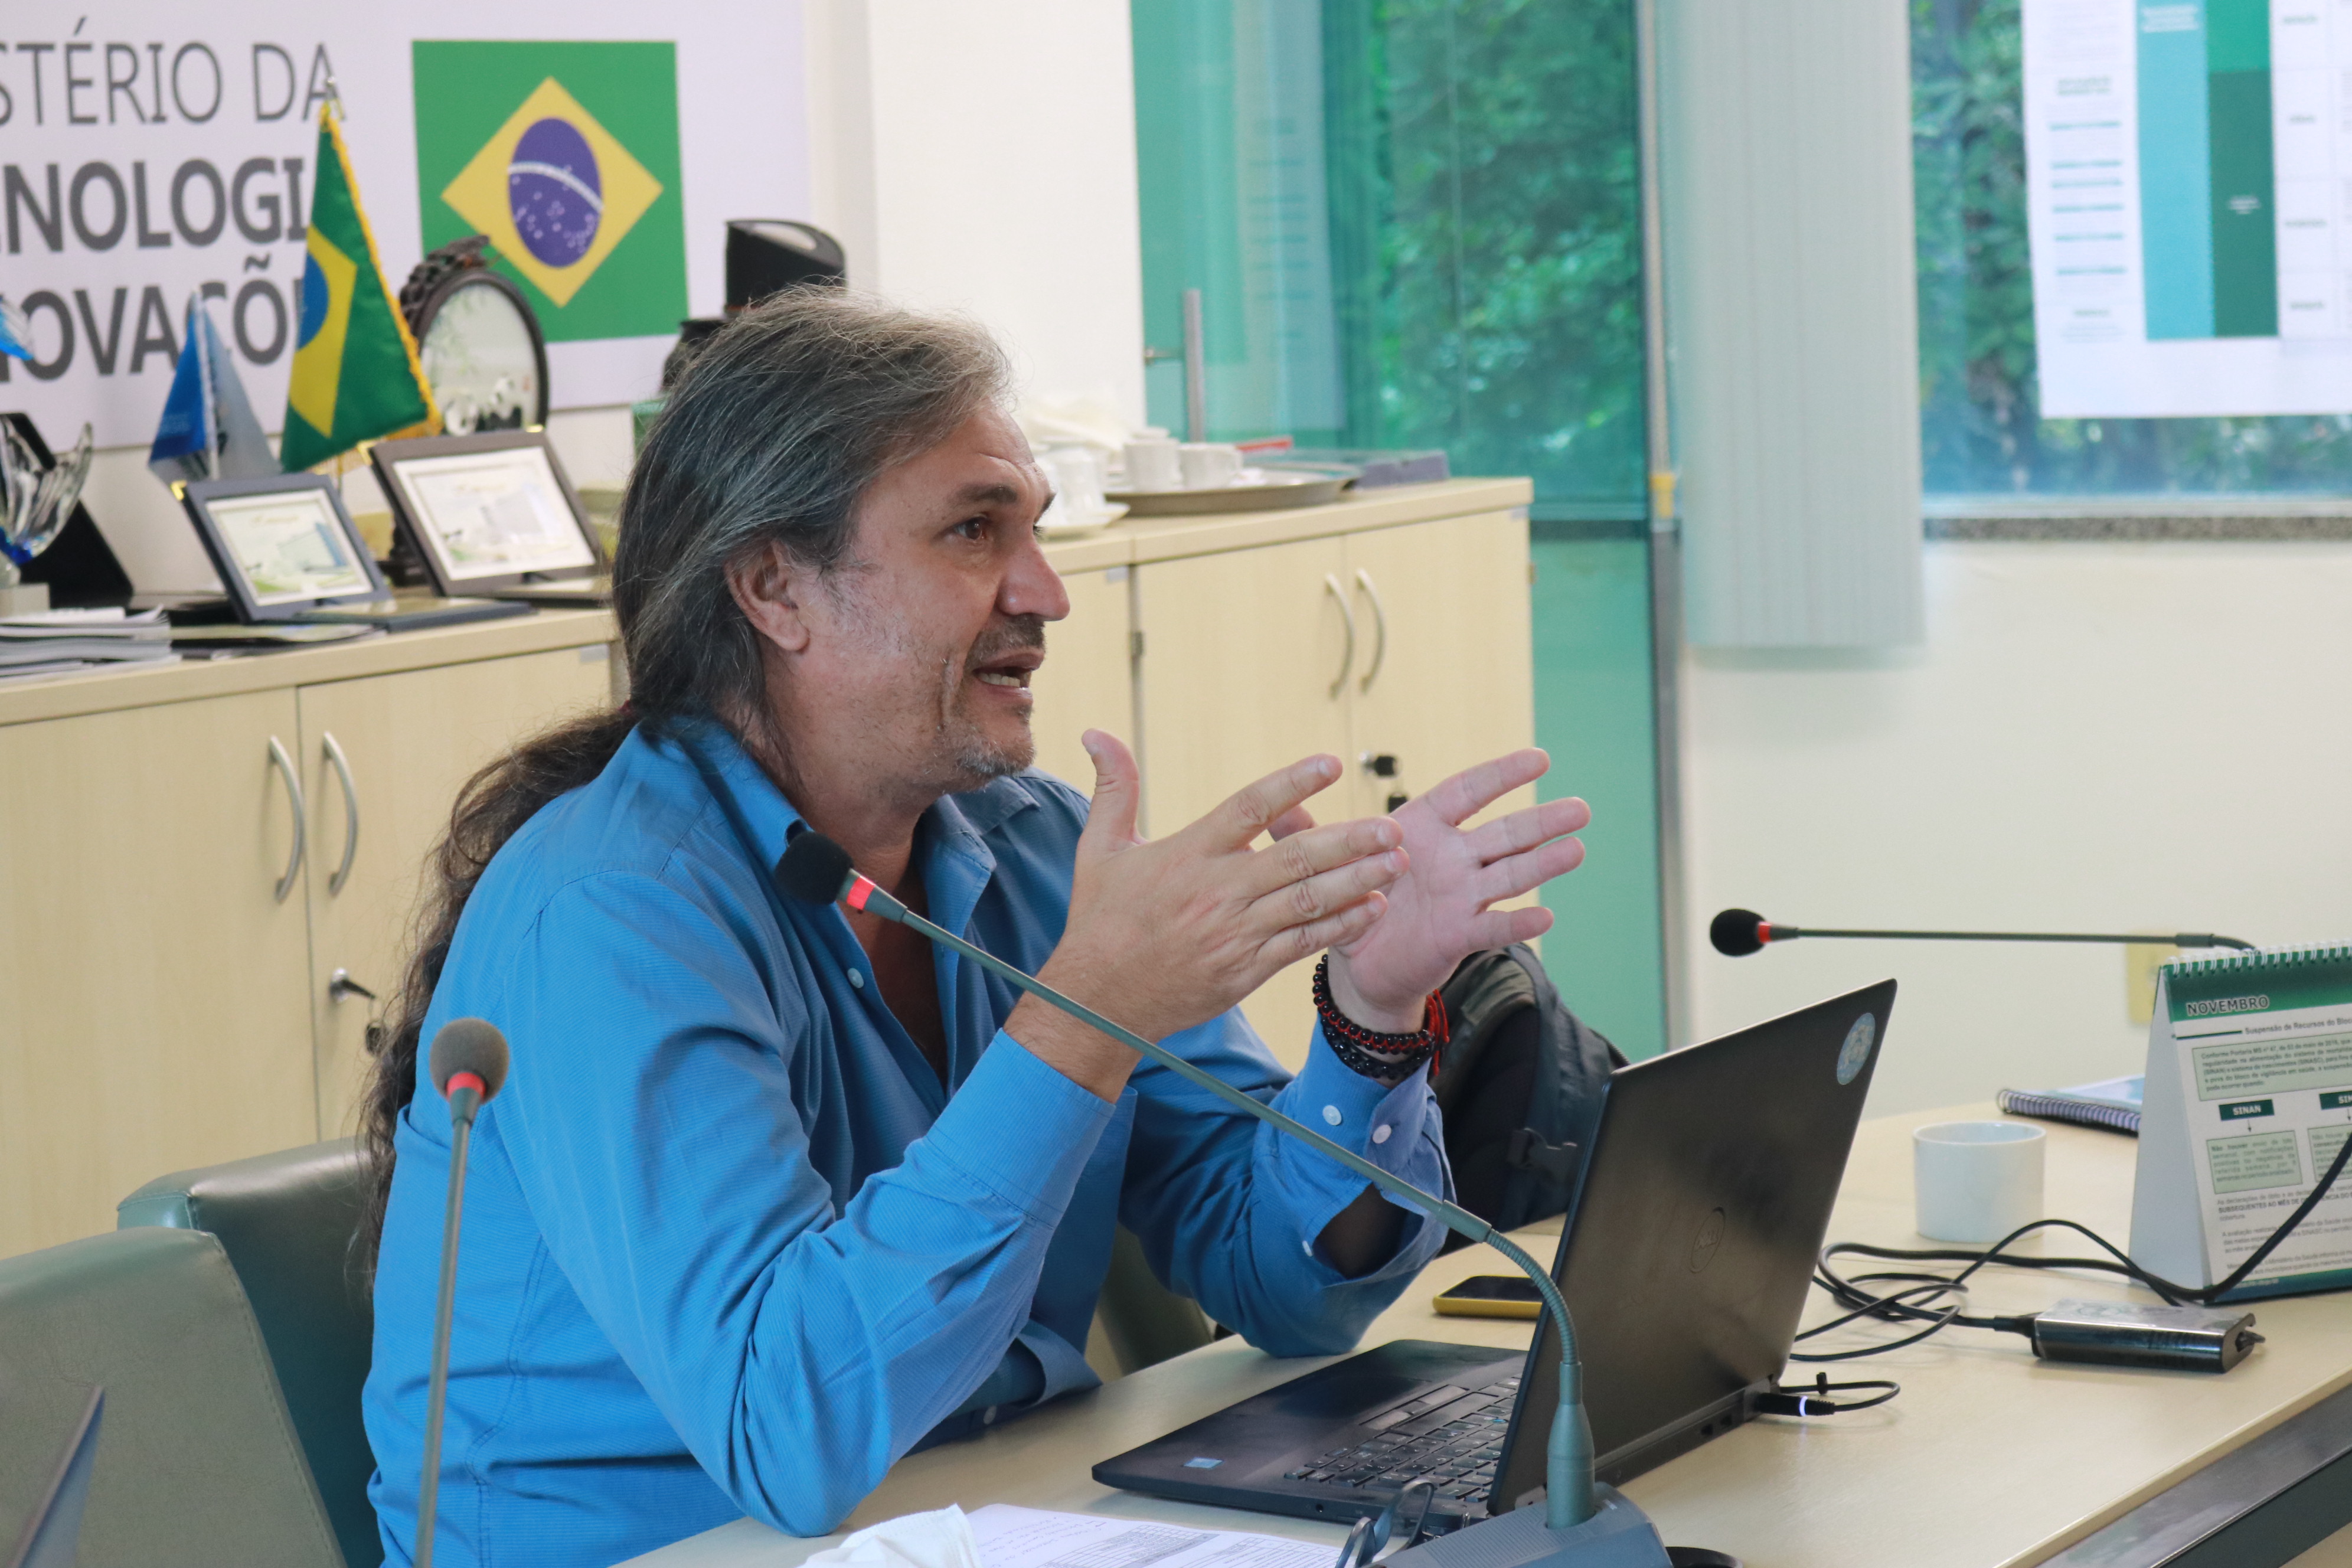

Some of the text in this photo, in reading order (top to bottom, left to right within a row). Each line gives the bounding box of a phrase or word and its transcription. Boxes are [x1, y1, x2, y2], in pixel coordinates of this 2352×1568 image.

[253, 41, 346, 122] DA
[1, 157, 308, 254] NOLOGI
[0, 253, 303, 383] OVAÕ
[2187, 995, 2269, 1015] NOVEMBRO
[2294, 1021, 2324, 1030] Recursos
[2233, 1105, 2262, 1116] SINAN
